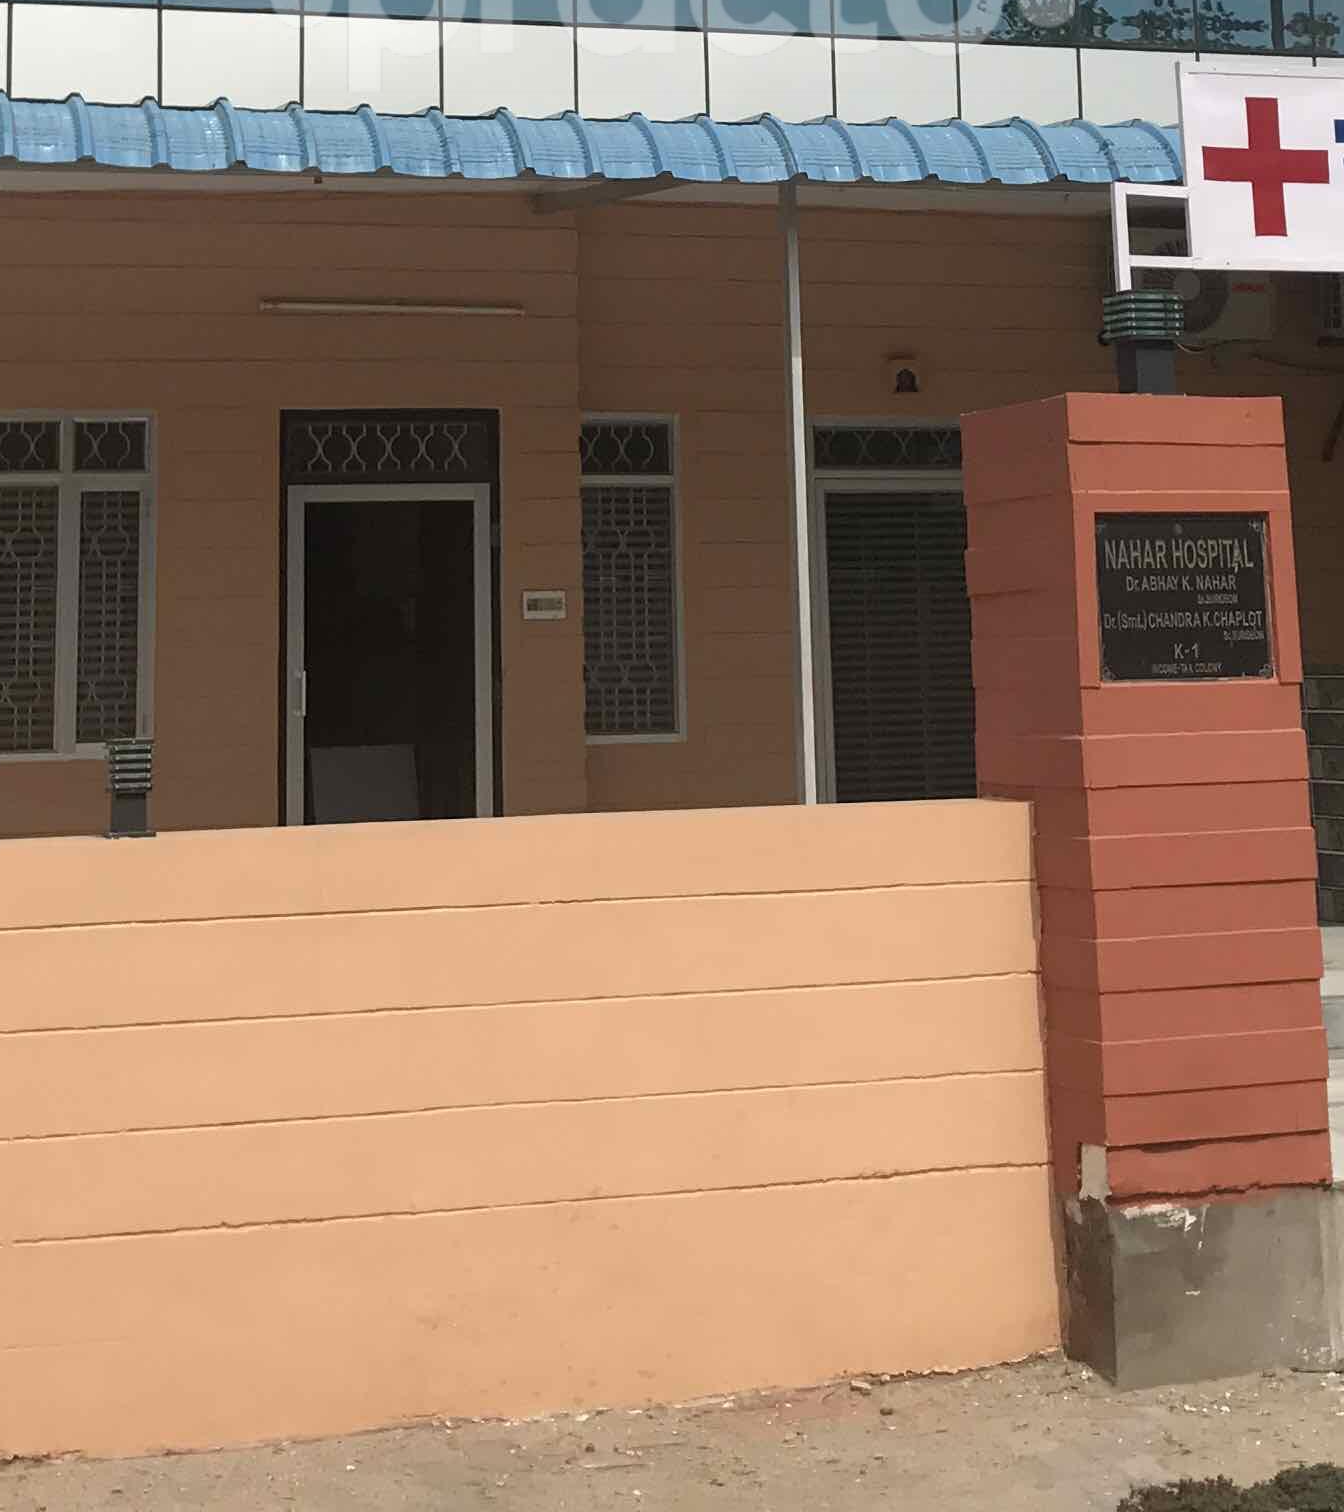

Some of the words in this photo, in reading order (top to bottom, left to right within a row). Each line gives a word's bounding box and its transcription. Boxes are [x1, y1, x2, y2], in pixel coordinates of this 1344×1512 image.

[1105, 539, 1168, 569] NAHAR
[1172, 538, 1254, 568] HOSPITAL
[1196, 574, 1237, 591] NAHAR
[1148, 610, 1201, 629] CHANDRA
[1174, 643, 1199, 659] K-1
